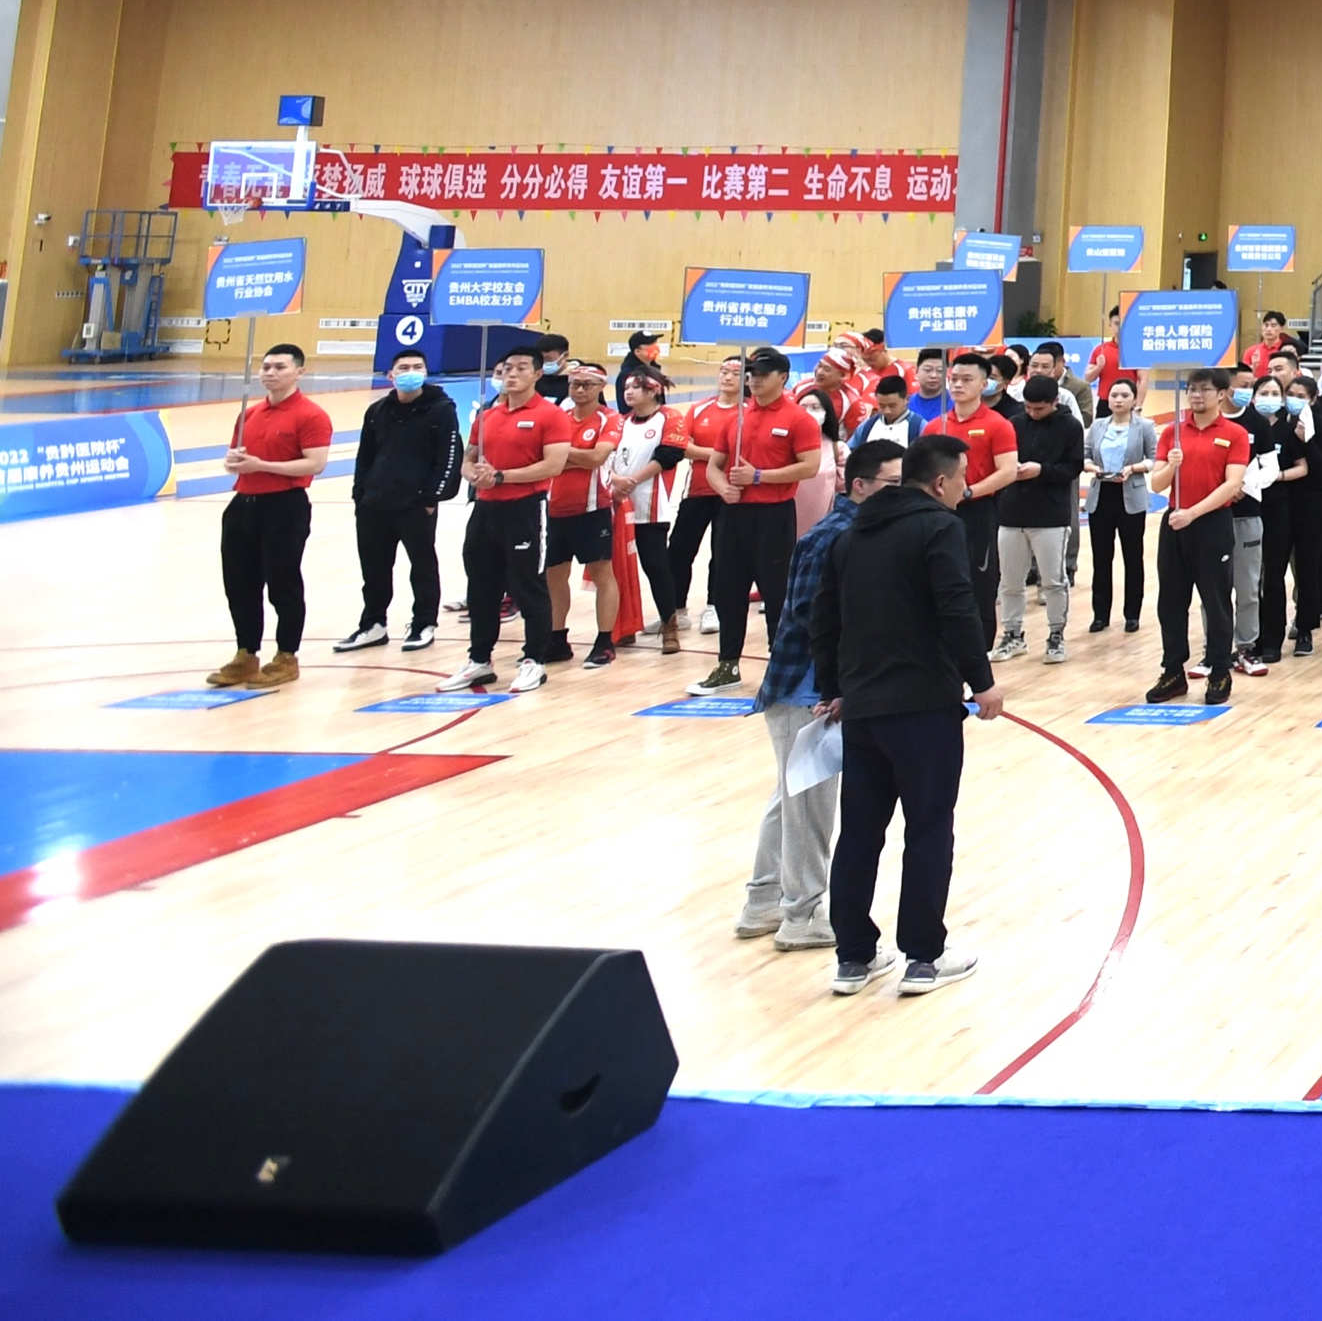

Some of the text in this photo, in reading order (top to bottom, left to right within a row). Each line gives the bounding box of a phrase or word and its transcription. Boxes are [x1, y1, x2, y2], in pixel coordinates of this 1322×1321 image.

[398, 162, 487, 200] 球球俱进
[499, 163, 589, 201] 分分必得
[600, 162, 688, 201] 友谊第一
[700, 163, 790, 201] 比赛第二
[803, 162, 893, 202] 生命不息
[906, 164, 958, 202] 运动
[215, 270, 294, 289] 贵州省天然饮用水
[233, 284, 273, 300] 行业协会
[403, 282, 432, 295] CITY
[448, 281, 526, 294] 贵州大学校友会
[448, 295, 524, 307] EMBA校友分会
[702, 299, 788, 317] 贵州省养老服务
[907, 305, 979, 320] 贵州名豪康养
[719, 314, 769, 329] 行业协会
[919, 318, 968, 333] 产业集团
[401, 320, 418, 341] 4
[1142, 324, 1214, 339] 华贵人寿保险
[1142, 337, 1214, 352] 股份有限公司
[0, 448, 29, 466] 022
